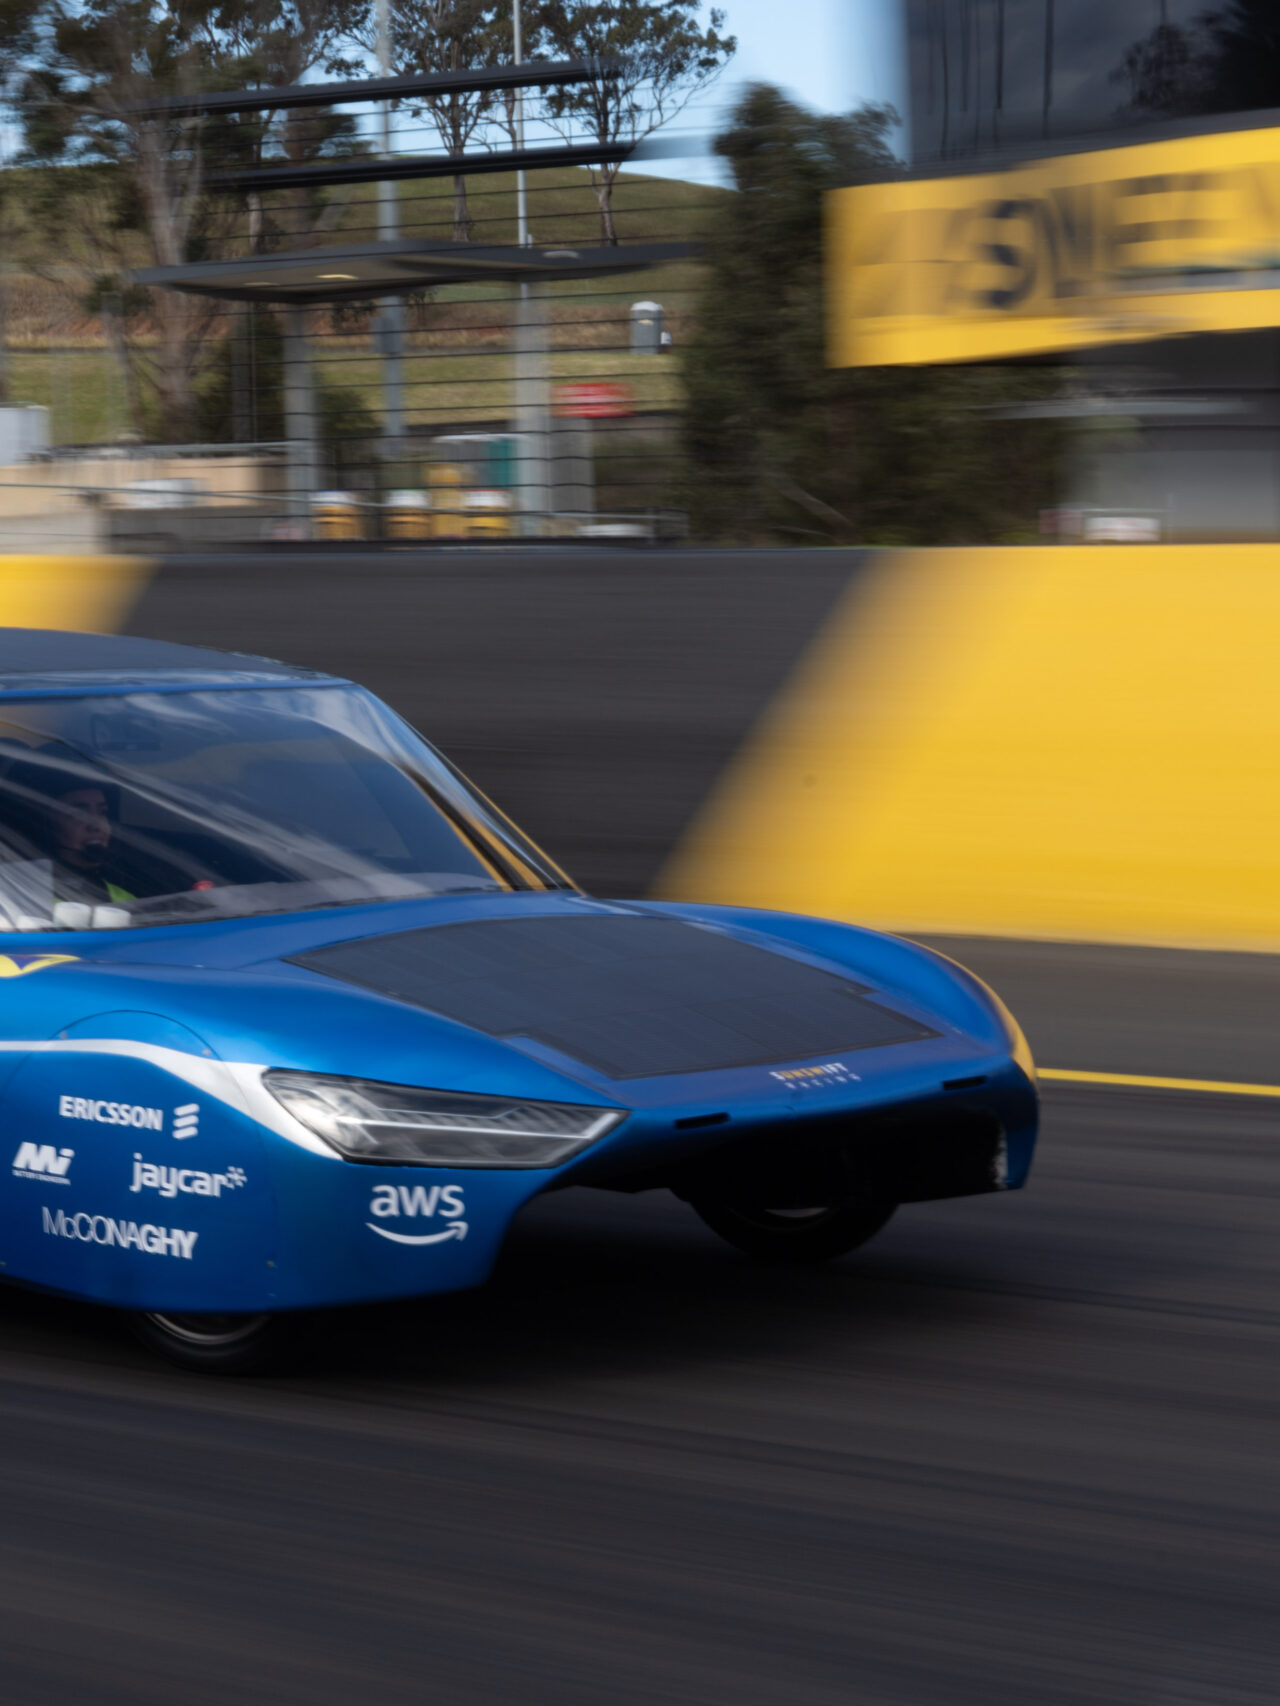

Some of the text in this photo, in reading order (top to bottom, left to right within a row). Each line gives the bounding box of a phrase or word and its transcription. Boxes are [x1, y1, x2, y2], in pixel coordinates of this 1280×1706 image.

[59, 1095, 164, 1132] ERICSSON
[129, 1152, 223, 1198] jaycar
[369, 1184, 466, 1218] aws
[42, 1206, 199, 1260] McCONAGHY
